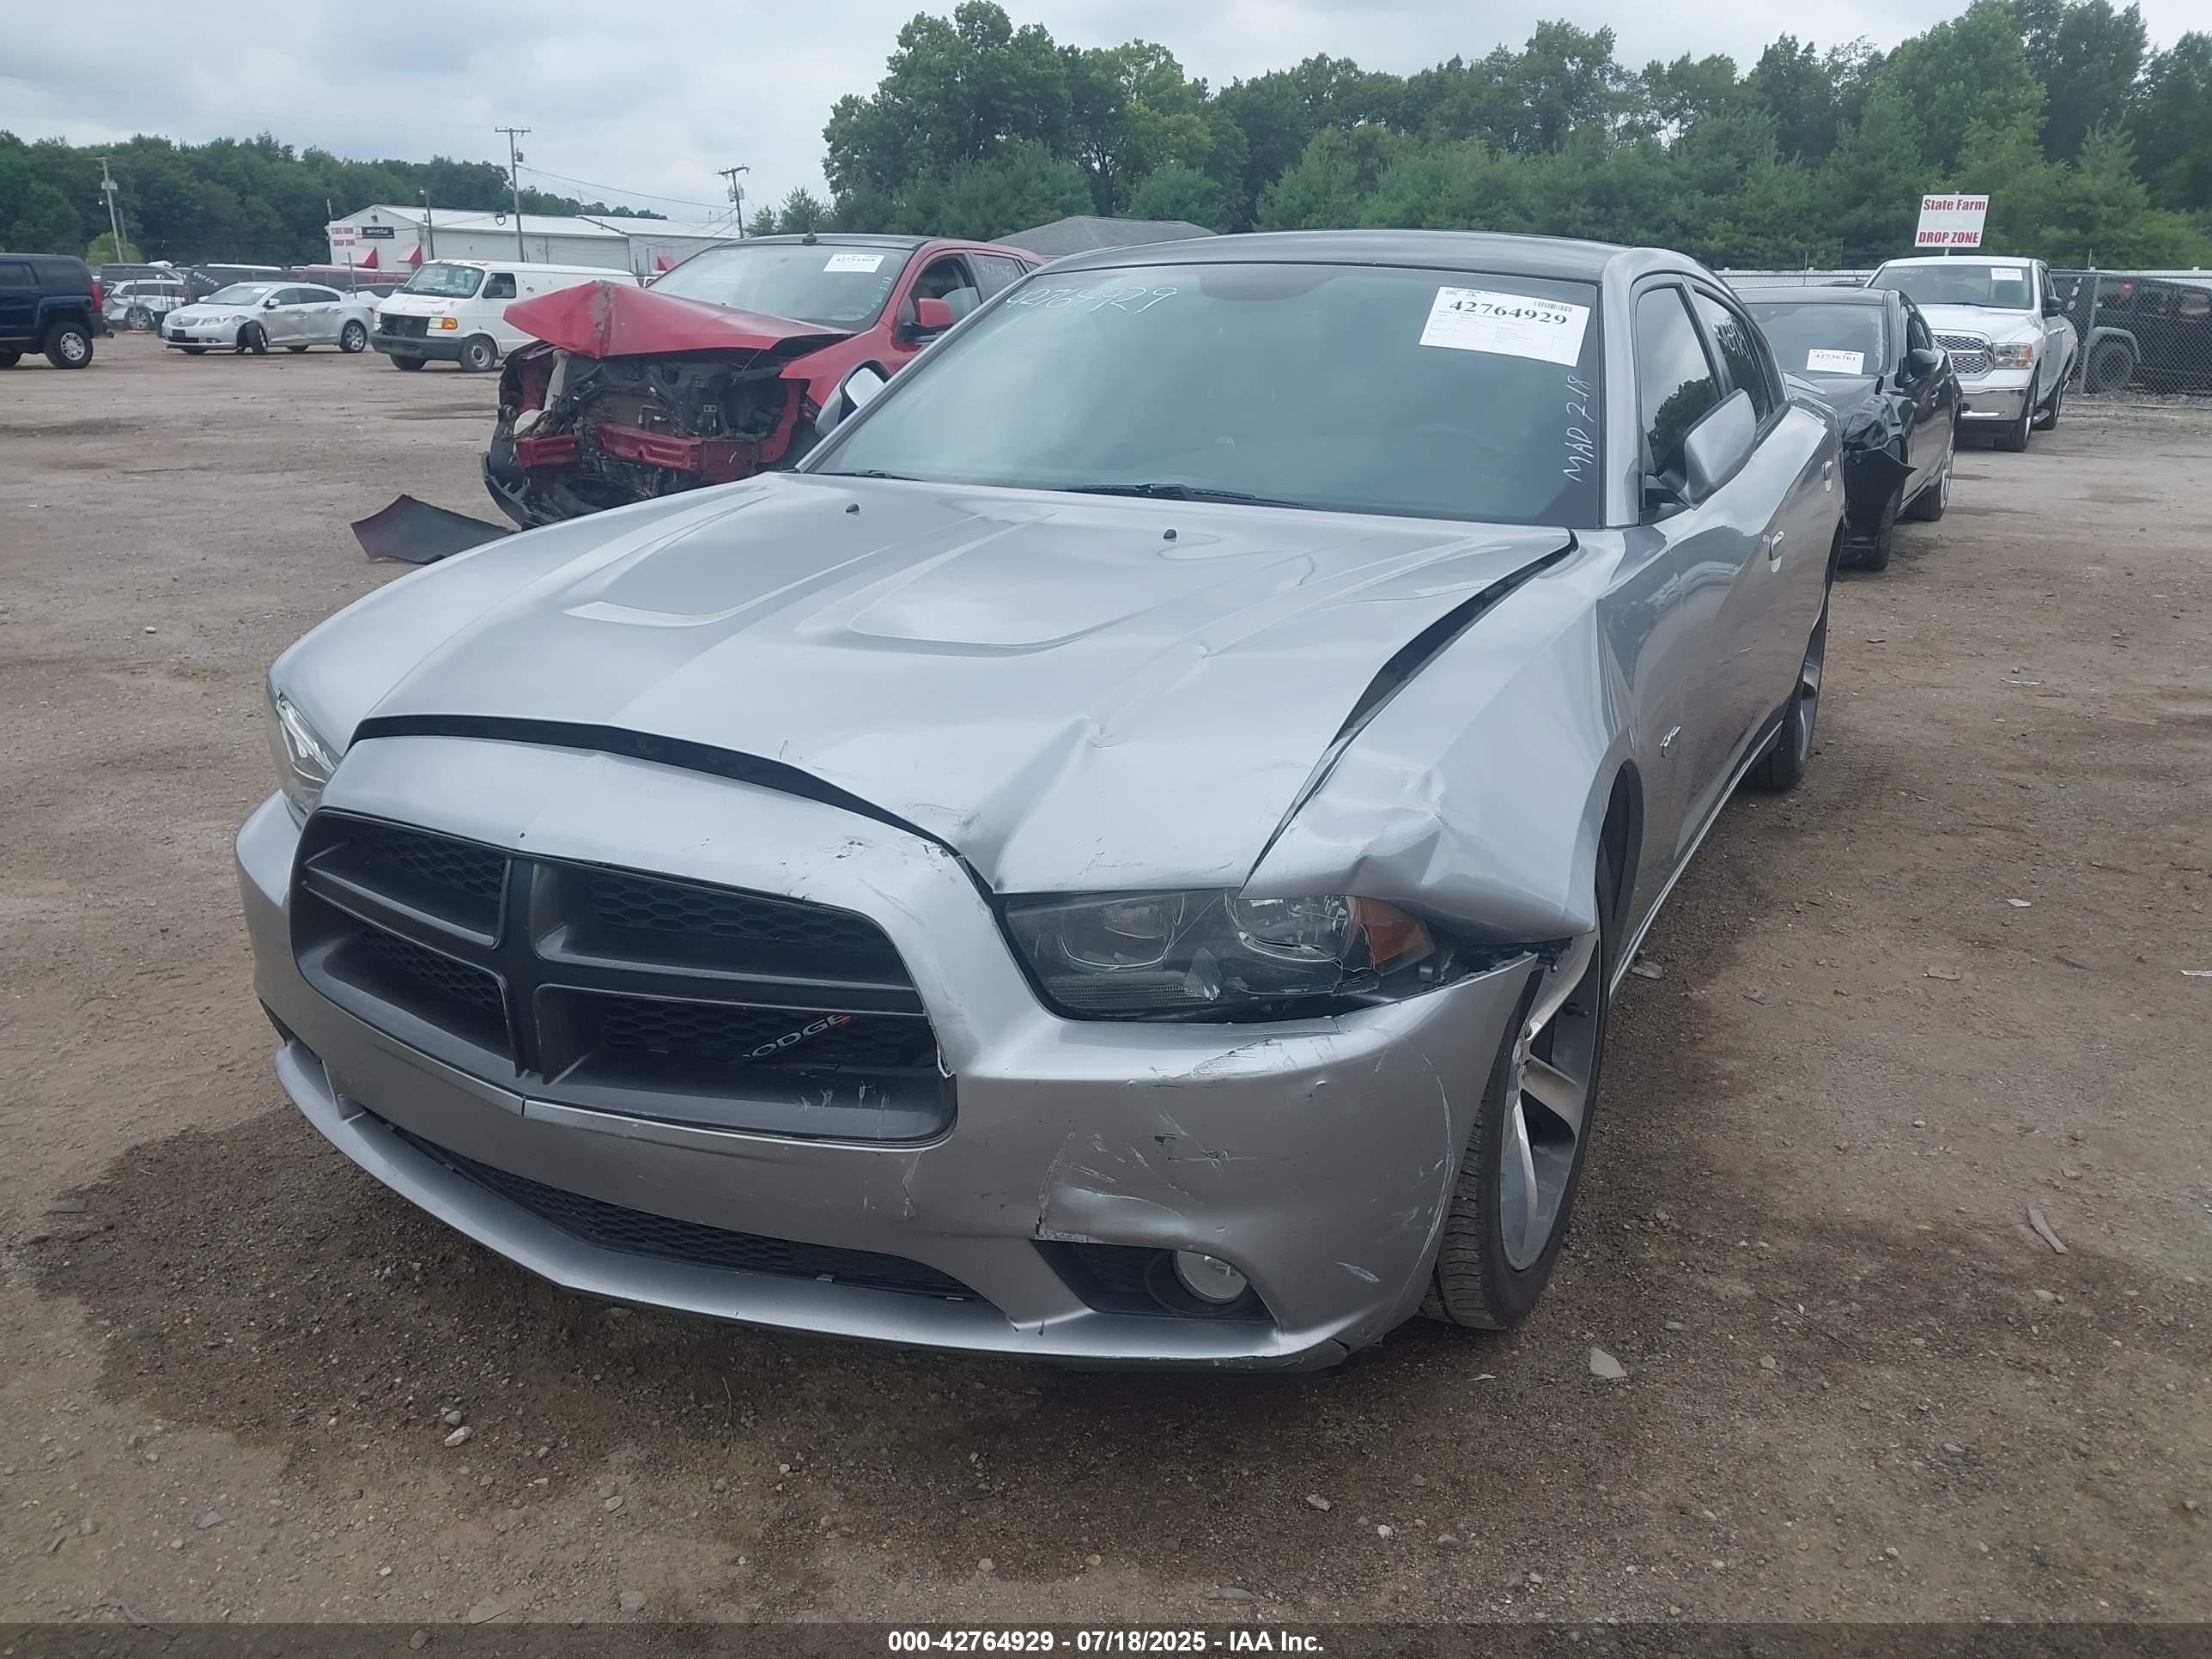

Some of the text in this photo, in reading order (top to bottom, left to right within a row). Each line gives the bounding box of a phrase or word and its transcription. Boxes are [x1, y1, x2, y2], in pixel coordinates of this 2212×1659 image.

[1923, 199, 1986, 211] State Farm
[1918, 231, 1979, 244] DROP ZONE
[1449, 301, 1568, 325] 42764929
[1563, 427, 1595, 482] MAD
[741, 1014, 845, 1057] ODGE
